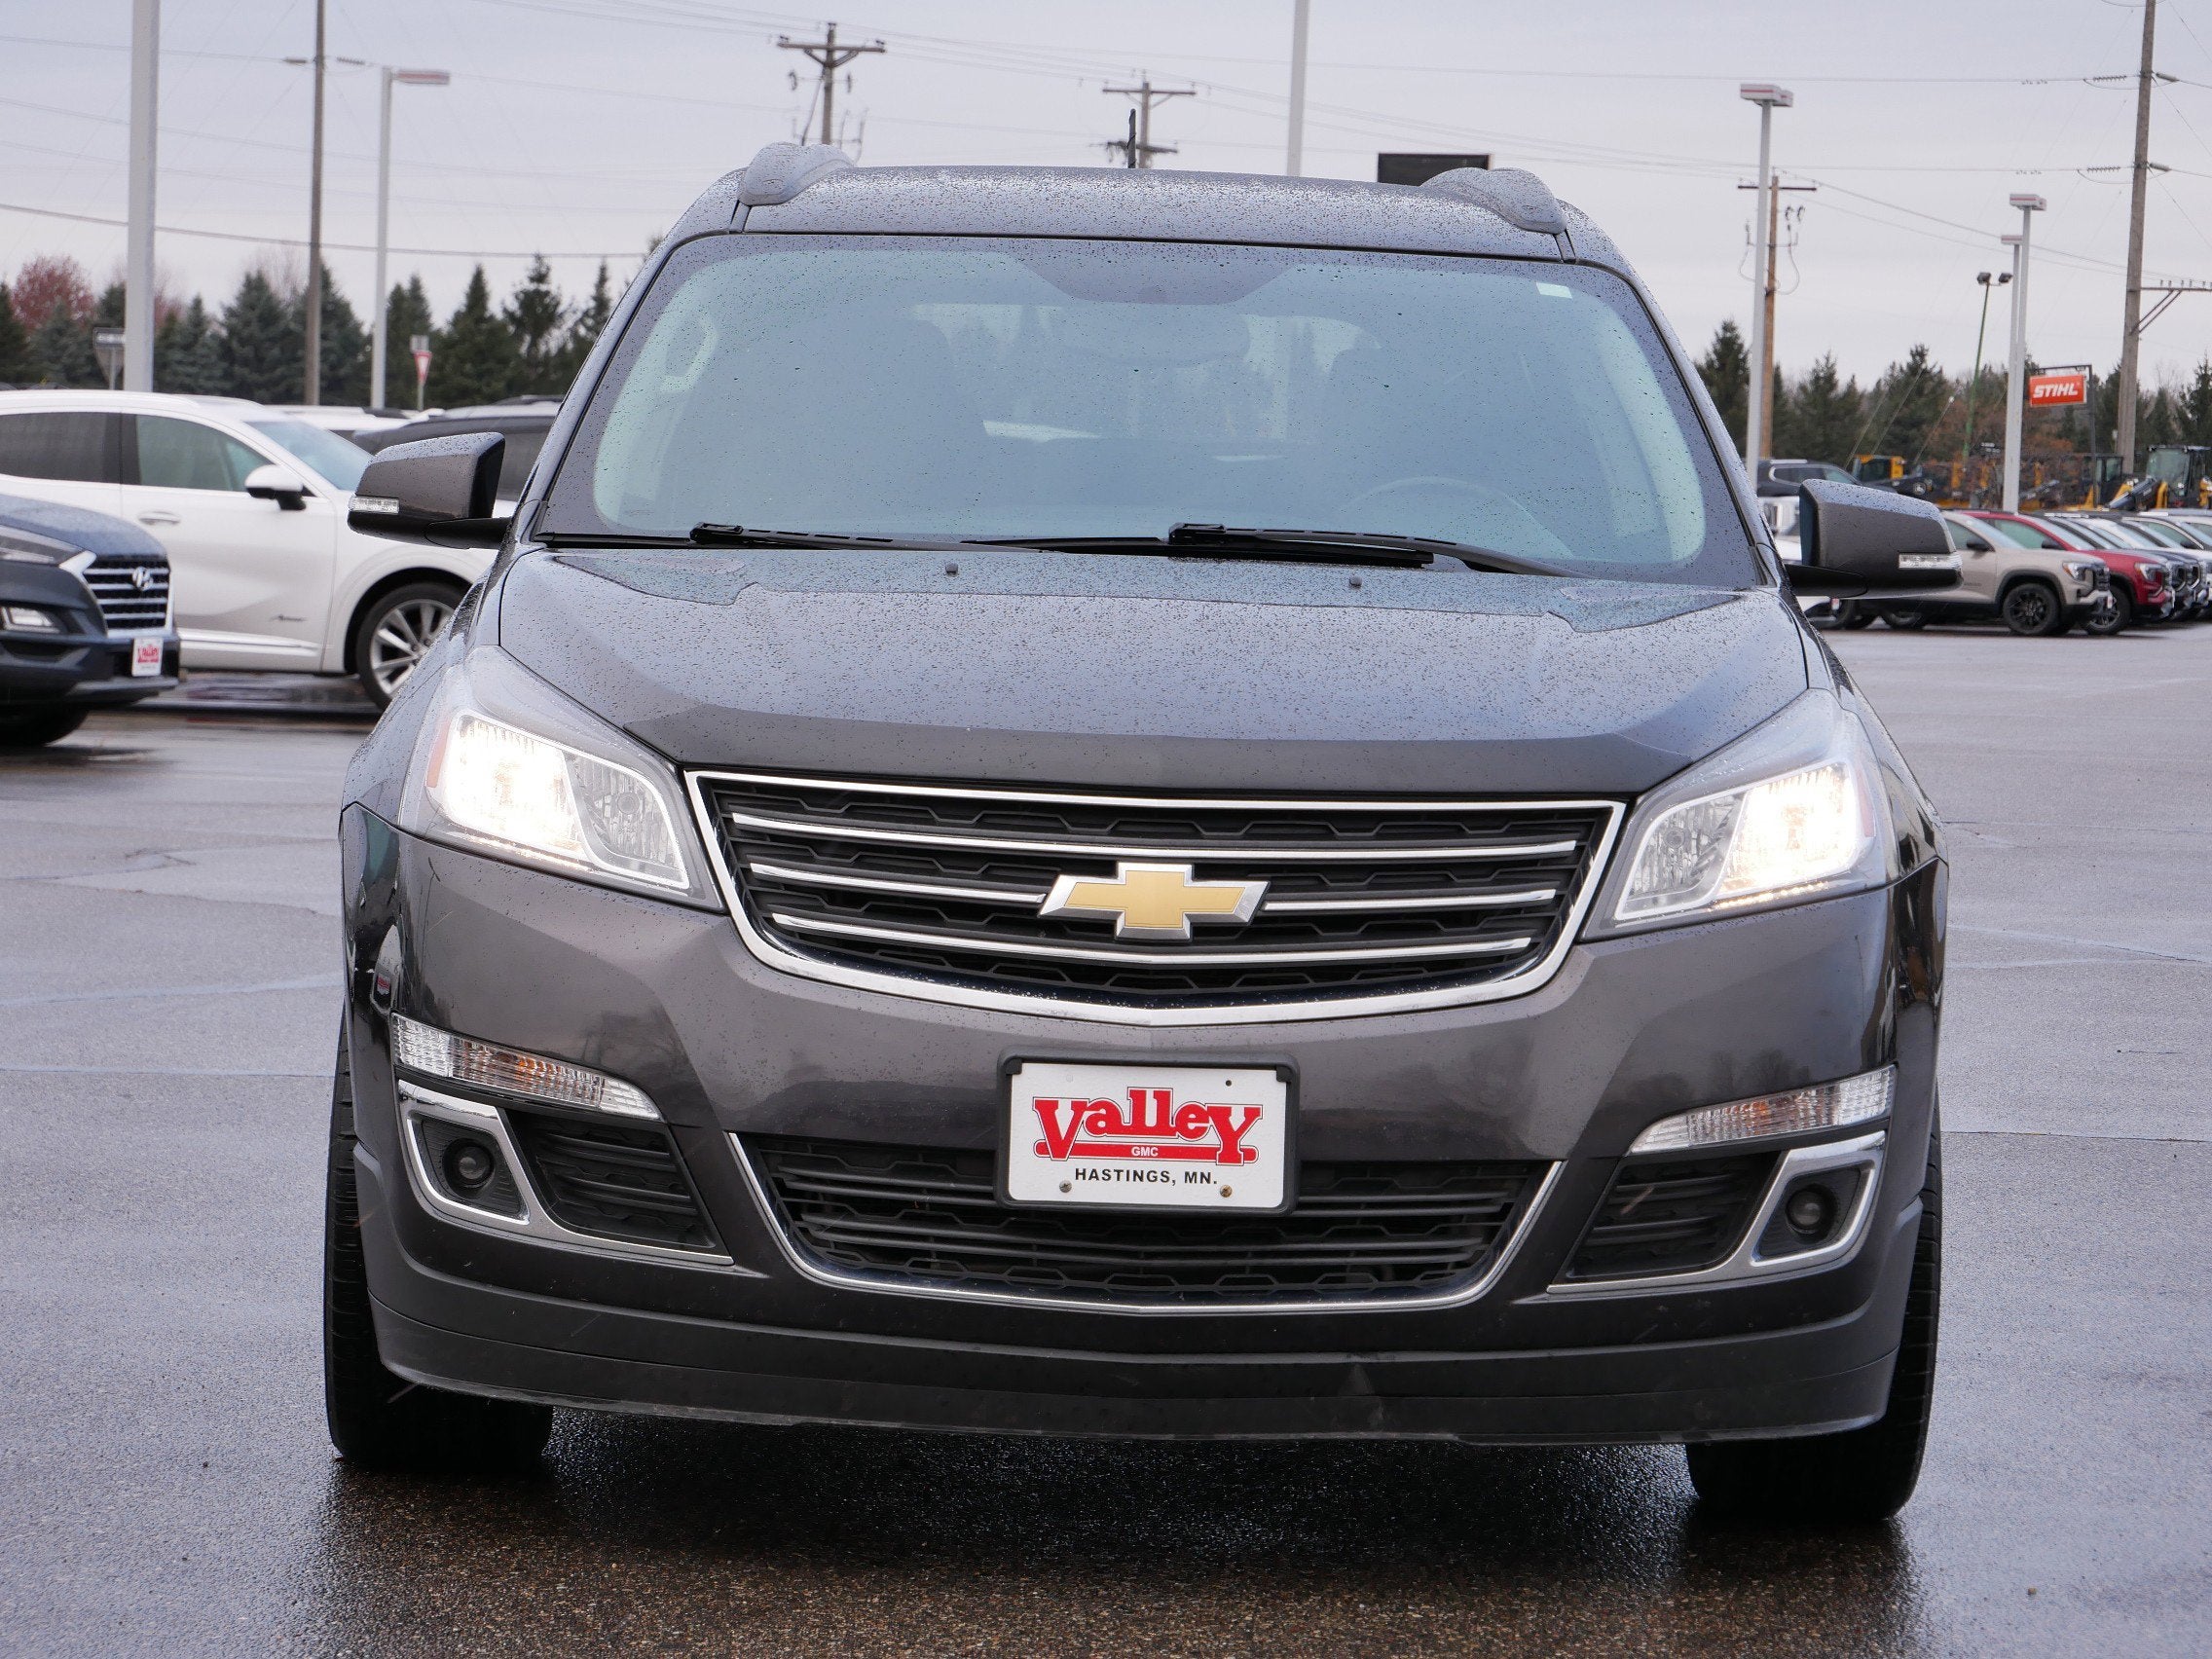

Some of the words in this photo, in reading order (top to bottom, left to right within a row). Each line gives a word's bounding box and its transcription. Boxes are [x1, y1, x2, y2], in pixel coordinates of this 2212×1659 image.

[2033, 382, 2079, 399] STIHL
[1130, 1146, 1159, 1157] GMC
[1075, 1167, 1176, 1186] HASTINGS,
[1184, 1170, 1217, 1184] MN.
